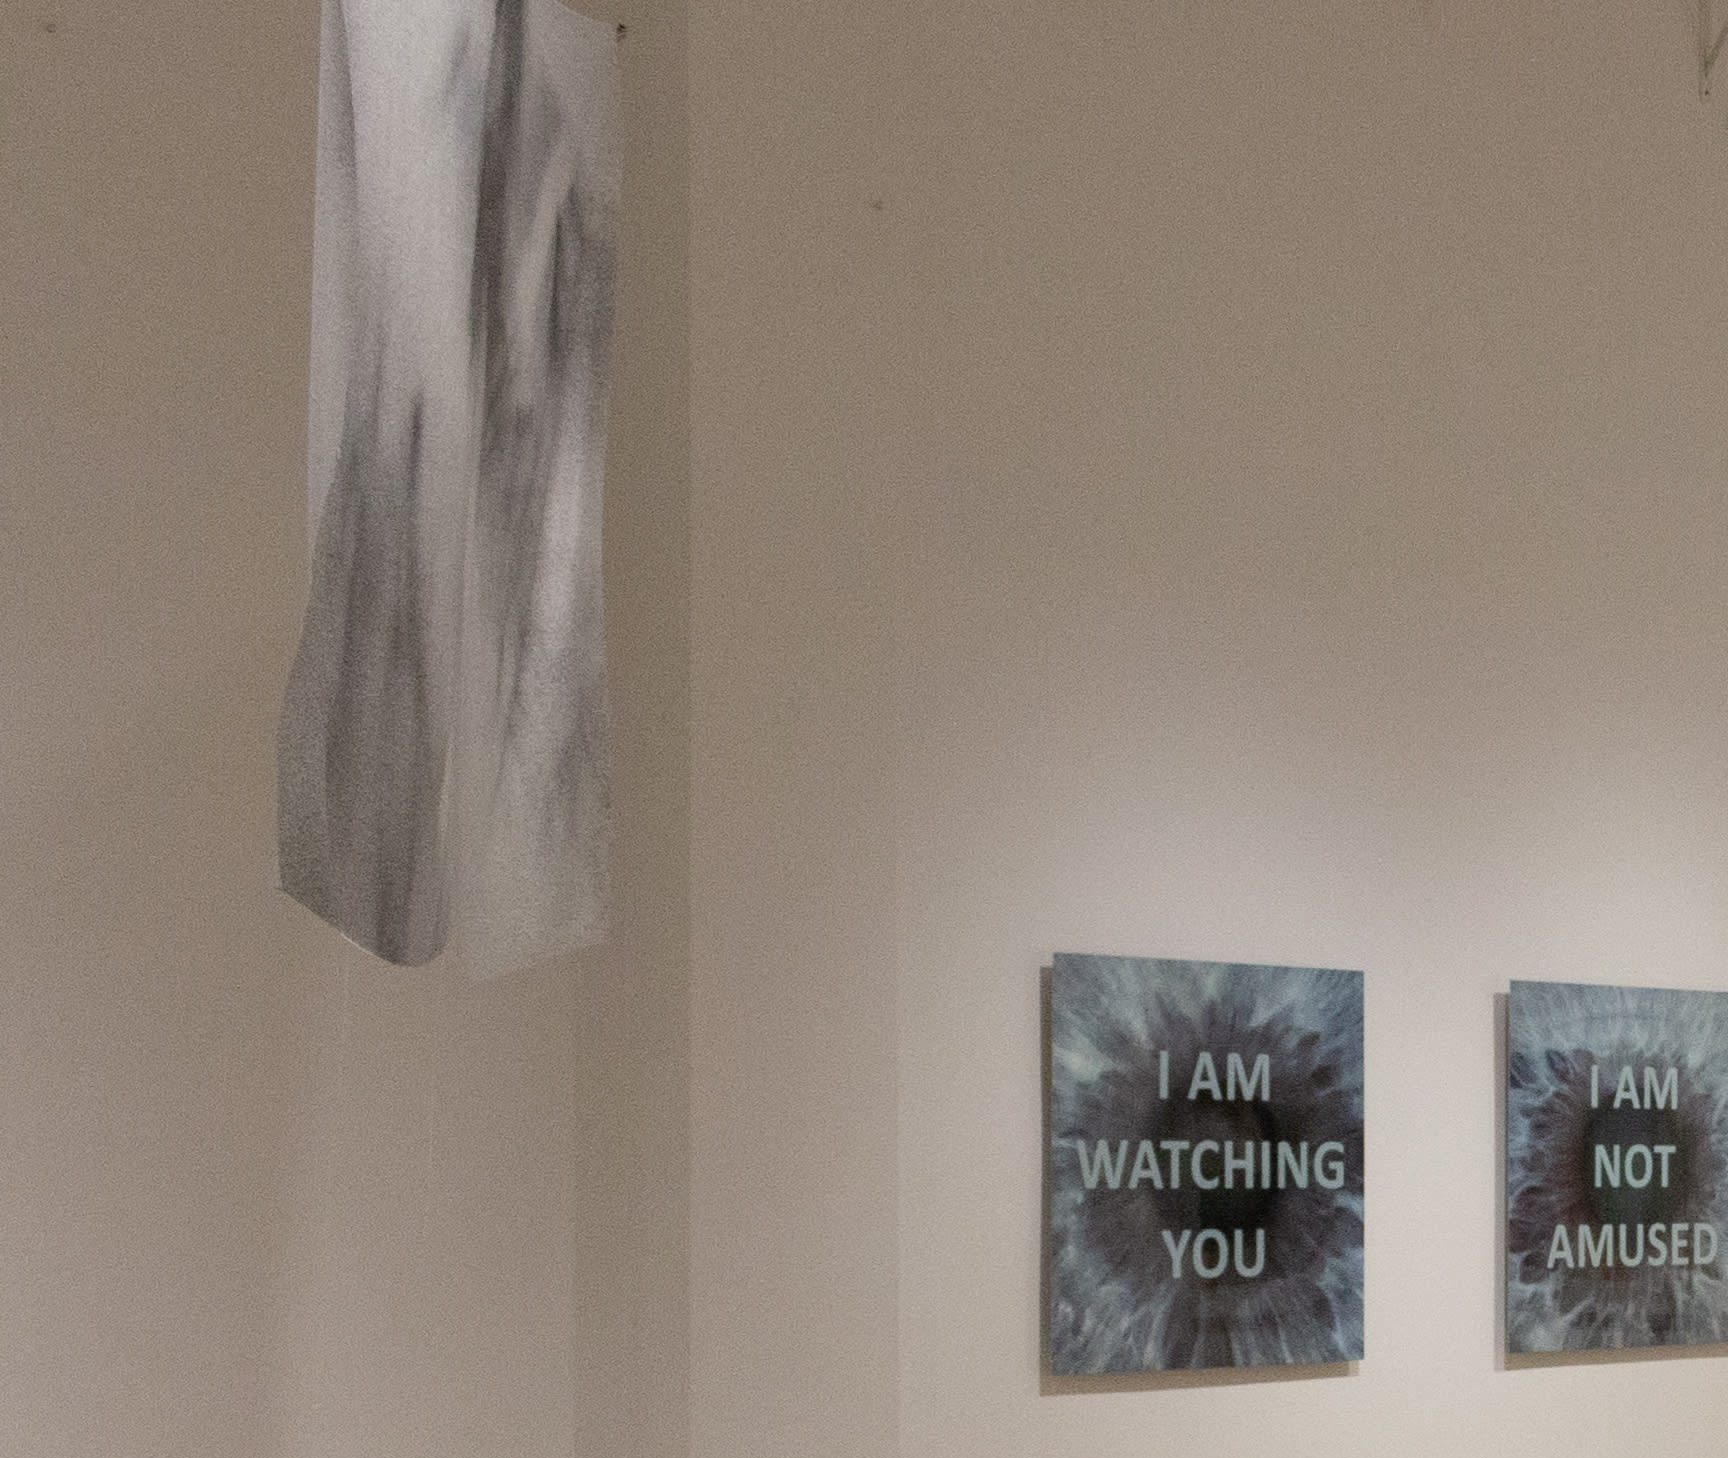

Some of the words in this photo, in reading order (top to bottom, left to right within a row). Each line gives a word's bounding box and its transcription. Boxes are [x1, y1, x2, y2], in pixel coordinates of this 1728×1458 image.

[1158, 1050, 1170, 1100] I
[1187, 1052, 1271, 1101] AM
[1590, 1064, 1599, 1109] I
[1613, 1065, 1679, 1110] AM
[1076, 1140, 1345, 1190] WATCHING
[1594, 1144, 1677, 1188] NOT
[1162, 1229, 1266, 1279] YOU
[1547, 1223, 1719, 1269] AMUSED
